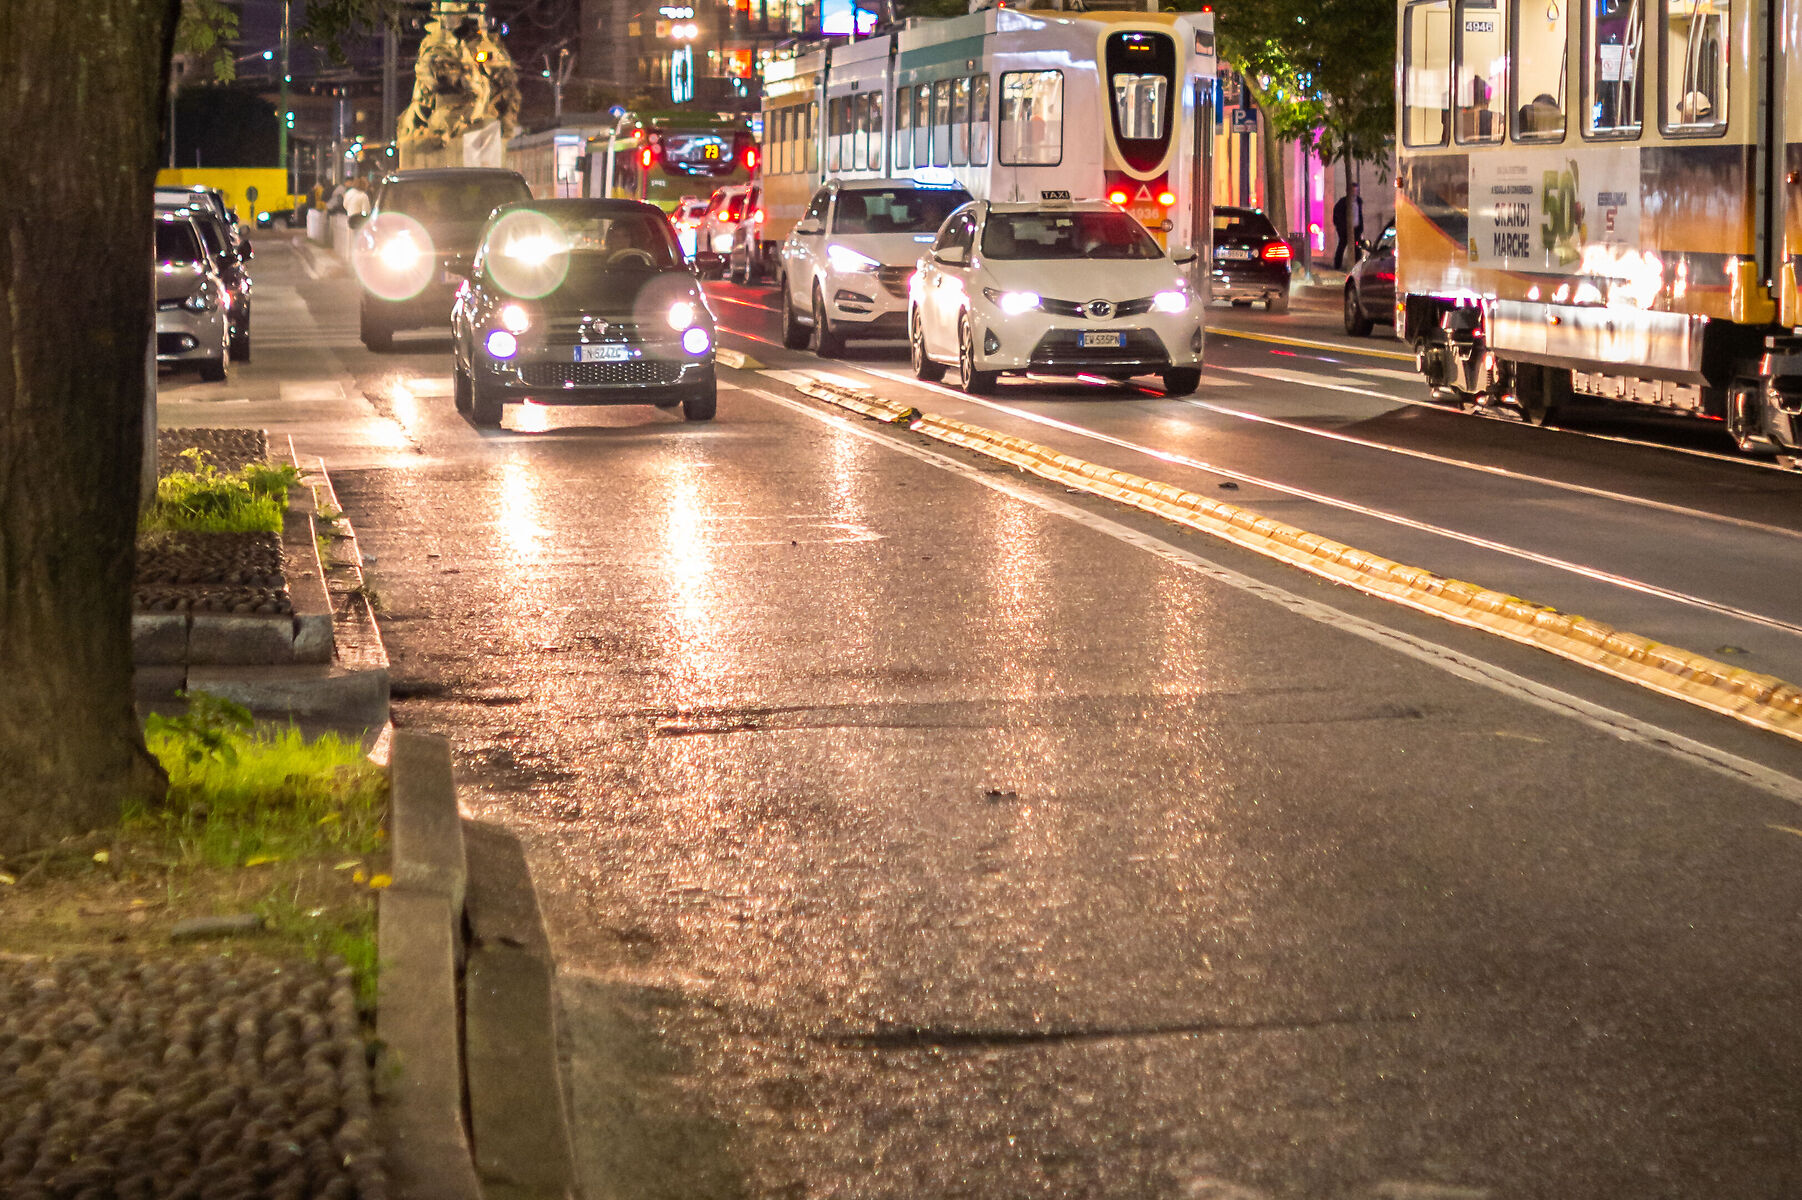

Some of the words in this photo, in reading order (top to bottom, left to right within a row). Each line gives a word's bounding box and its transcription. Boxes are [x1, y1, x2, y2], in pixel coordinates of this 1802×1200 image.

[1465, 22, 1493, 32] 4946
[704, 144, 719, 159] 73
[1042, 191, 1069, 200] TAXI
[1494, 202, 1530, 228] GRANDI
[1493, 231, 1530, 257] MARCHE
